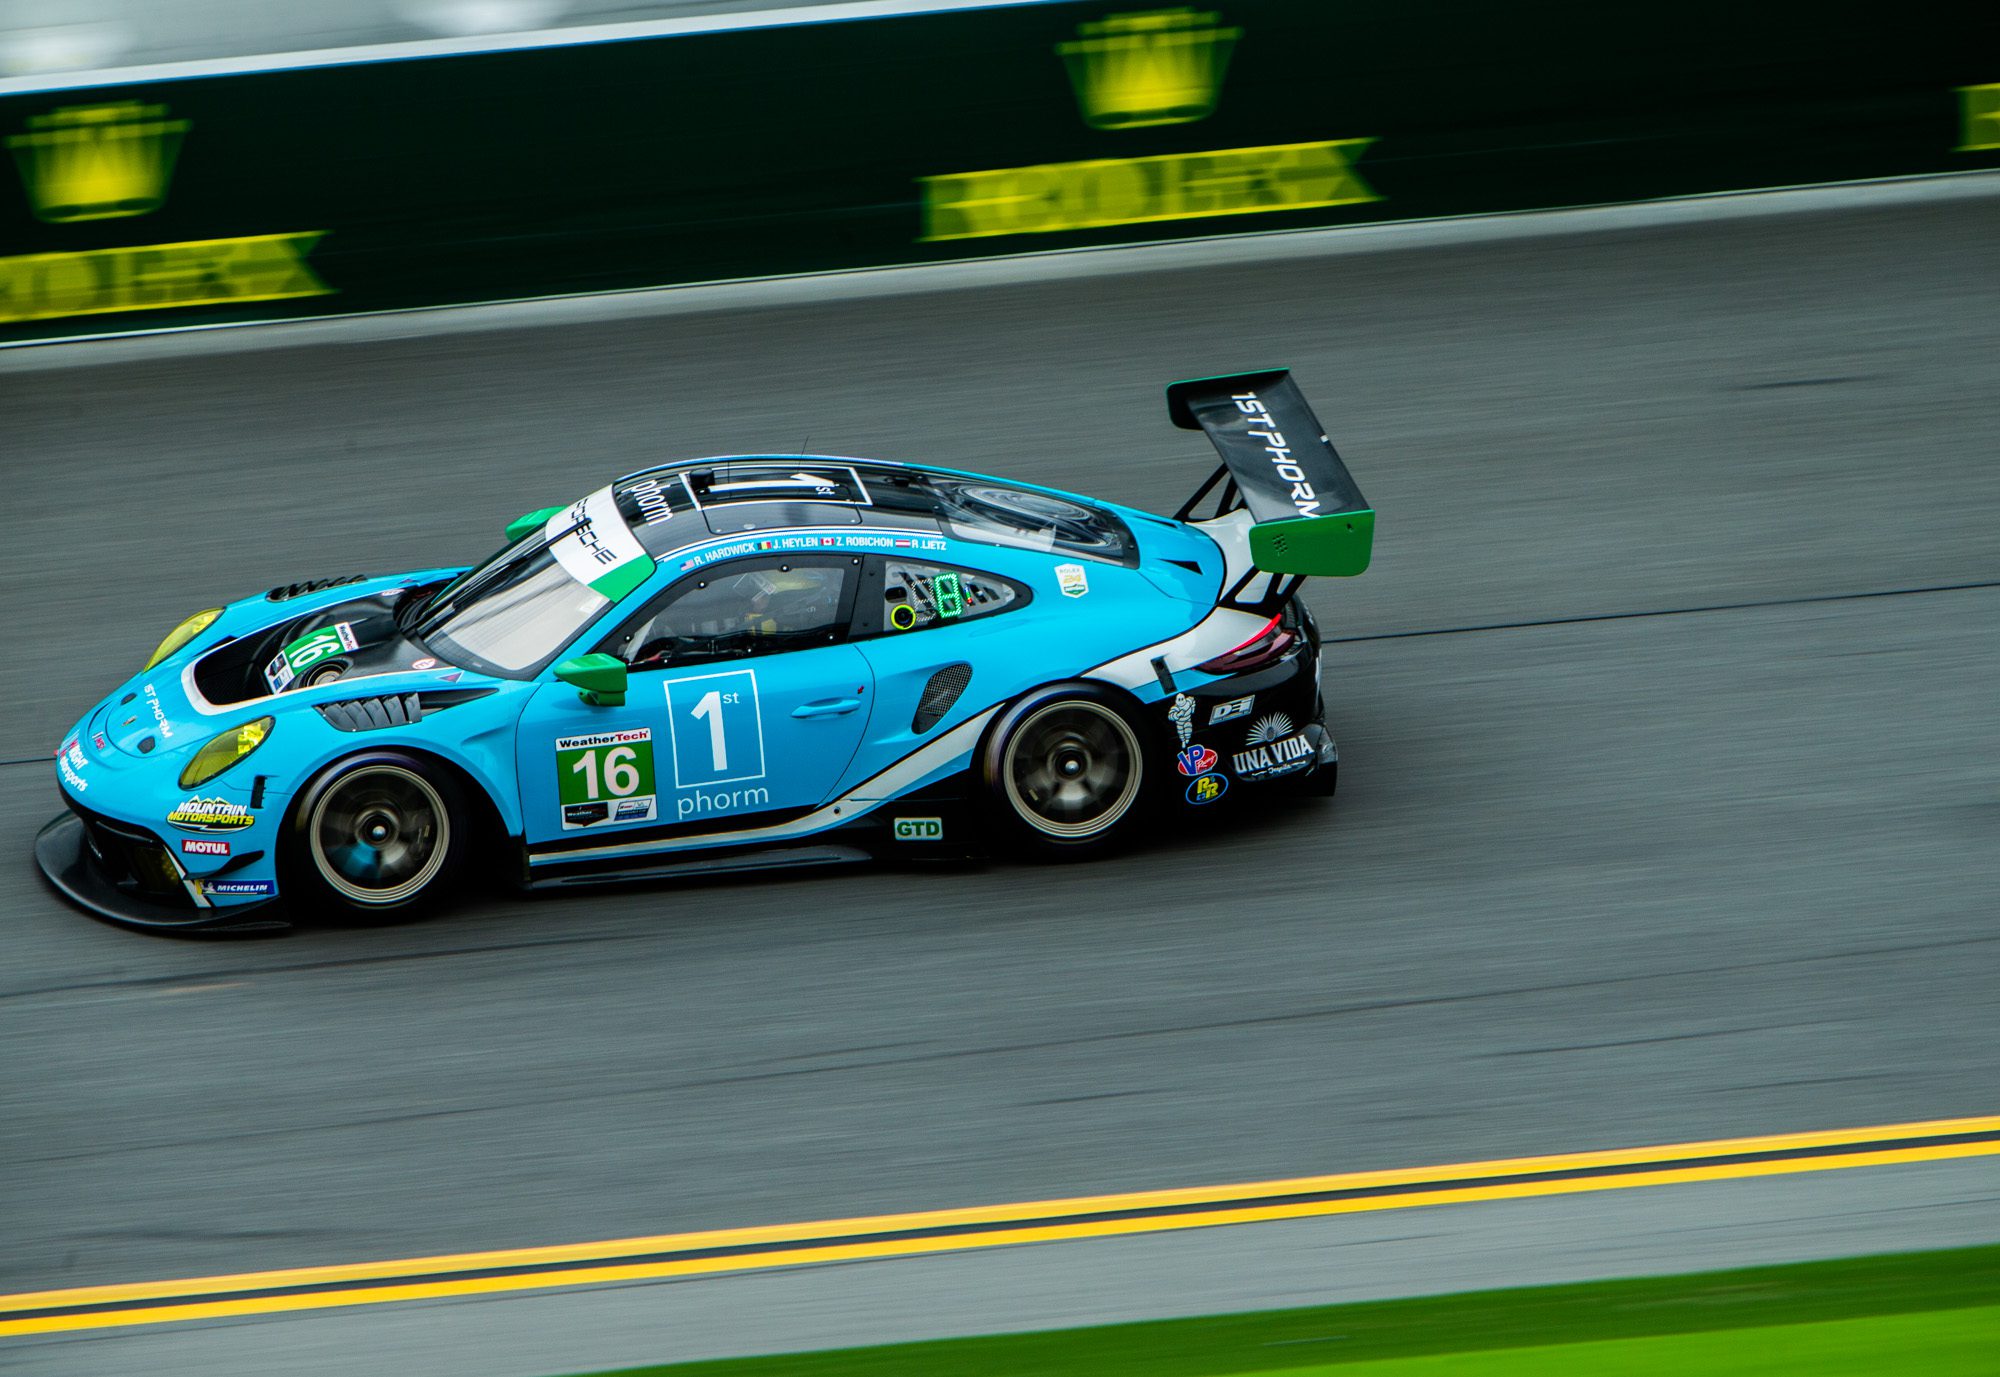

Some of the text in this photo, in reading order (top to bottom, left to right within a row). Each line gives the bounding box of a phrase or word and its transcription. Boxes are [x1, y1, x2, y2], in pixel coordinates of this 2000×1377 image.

[694, 556, 705, 566] R.
[705, 542, 756, 562] HARDWICK
[773, 539, 781, 549] J.
[783, 537, 818, 548] HEYLEN
[836, 537, 845, 547] Z.
[846, 537, 893, 547] ROBICHON
[288, 634, 341, 668] 16
[560, 731, 647, 748] WeatherTech
[1177, 744, 1205, 775] VP
[1232, 734, 1315, 774] UNA VIDA
[573, 747, 640, 799] 16
[177, 802, 248, 816] MOUNTAIN
[678, 787, 769, 820] phorm
[167, 812, 254, 825] MOTORSPORTS
[897, 821, 940, 837] GTD
[185, 842, 228, 853] MOTUL
[217, 884, 267, 892] MICHELIN
